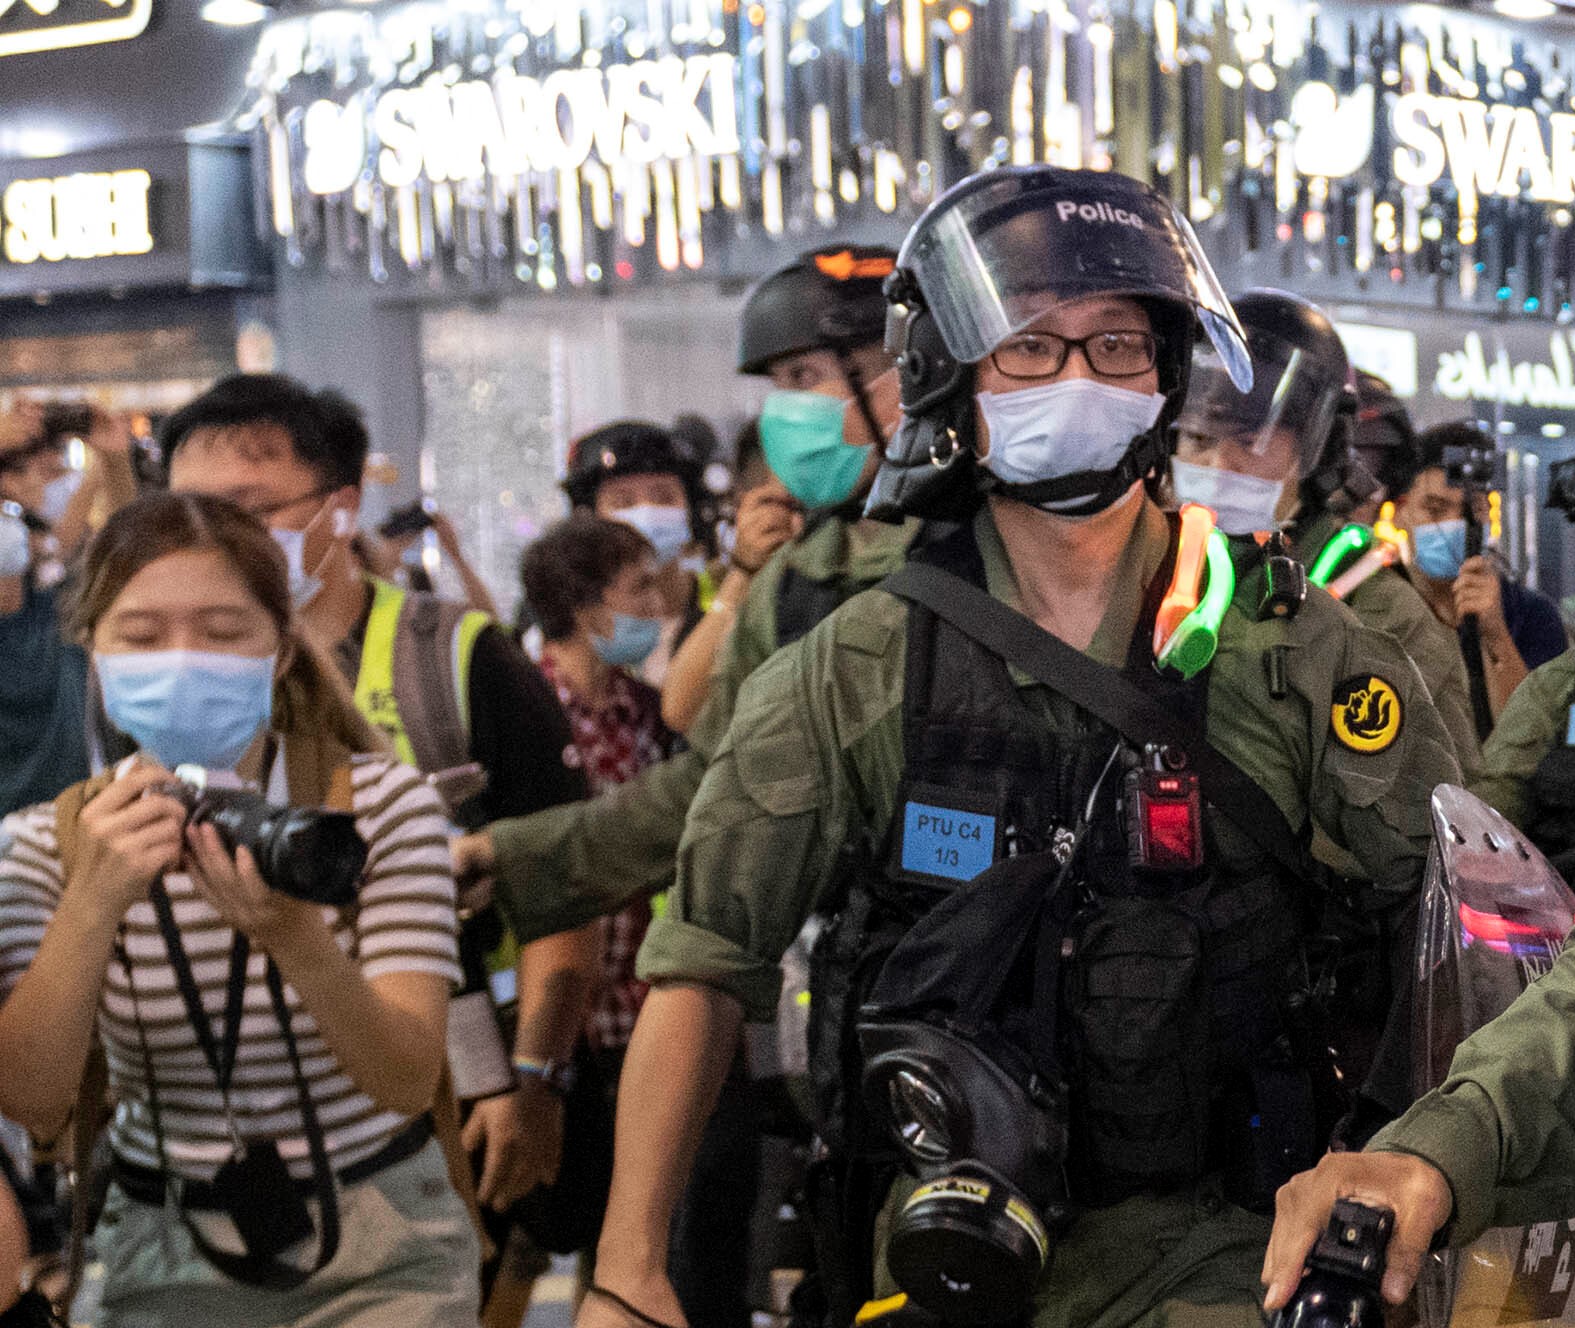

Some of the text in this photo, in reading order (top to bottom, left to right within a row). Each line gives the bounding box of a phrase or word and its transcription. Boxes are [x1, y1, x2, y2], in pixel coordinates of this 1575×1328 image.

[375, 52, 741, 187] SWAROVSKI
[1056, 200, 1143, 230] Police
[918, 814, 981, 841] PTU C4
[935, 848, 959, 867] 1/3
